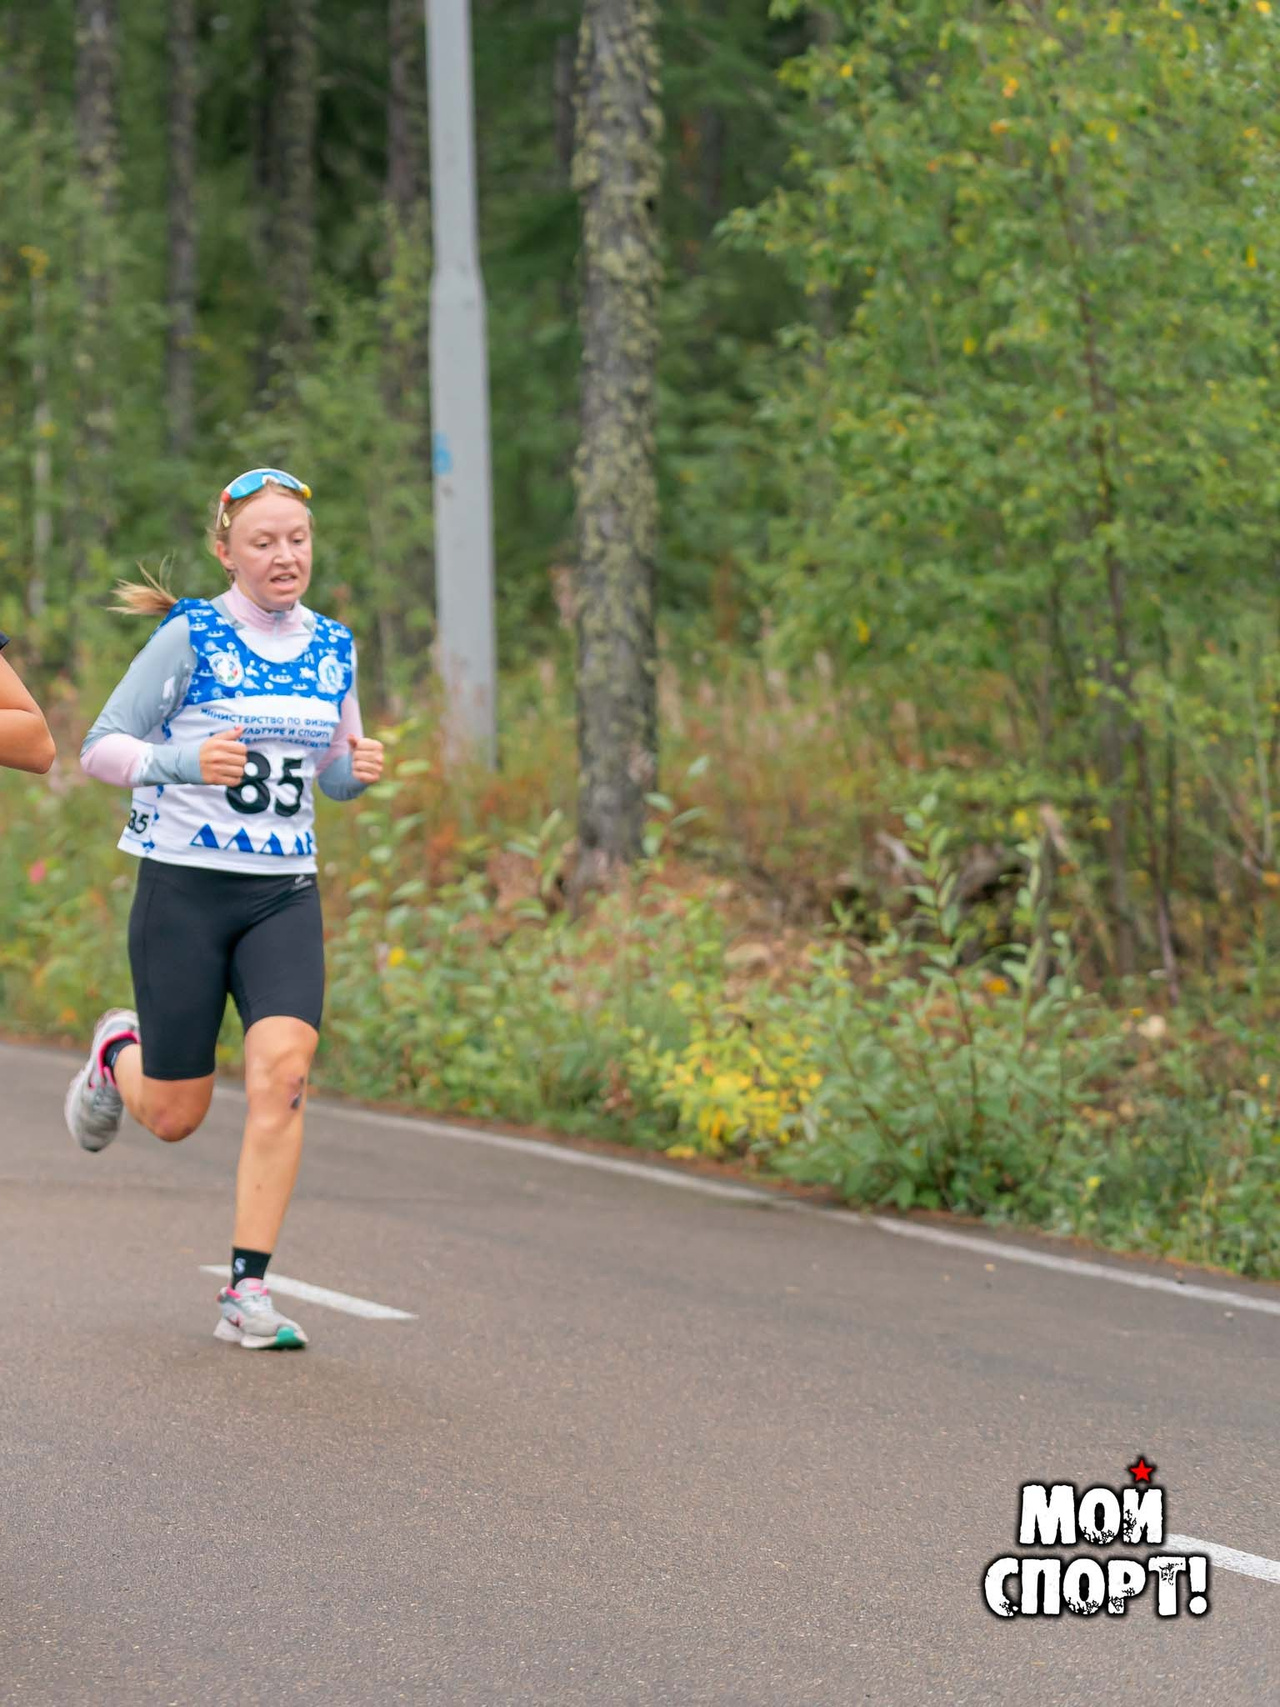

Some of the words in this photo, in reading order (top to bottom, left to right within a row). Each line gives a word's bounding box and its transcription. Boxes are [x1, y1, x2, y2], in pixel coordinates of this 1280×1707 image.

[287, 716, 301, 725] ПО
[289, 728, 296, 736] И
[225, 751, 305, 817] 85
